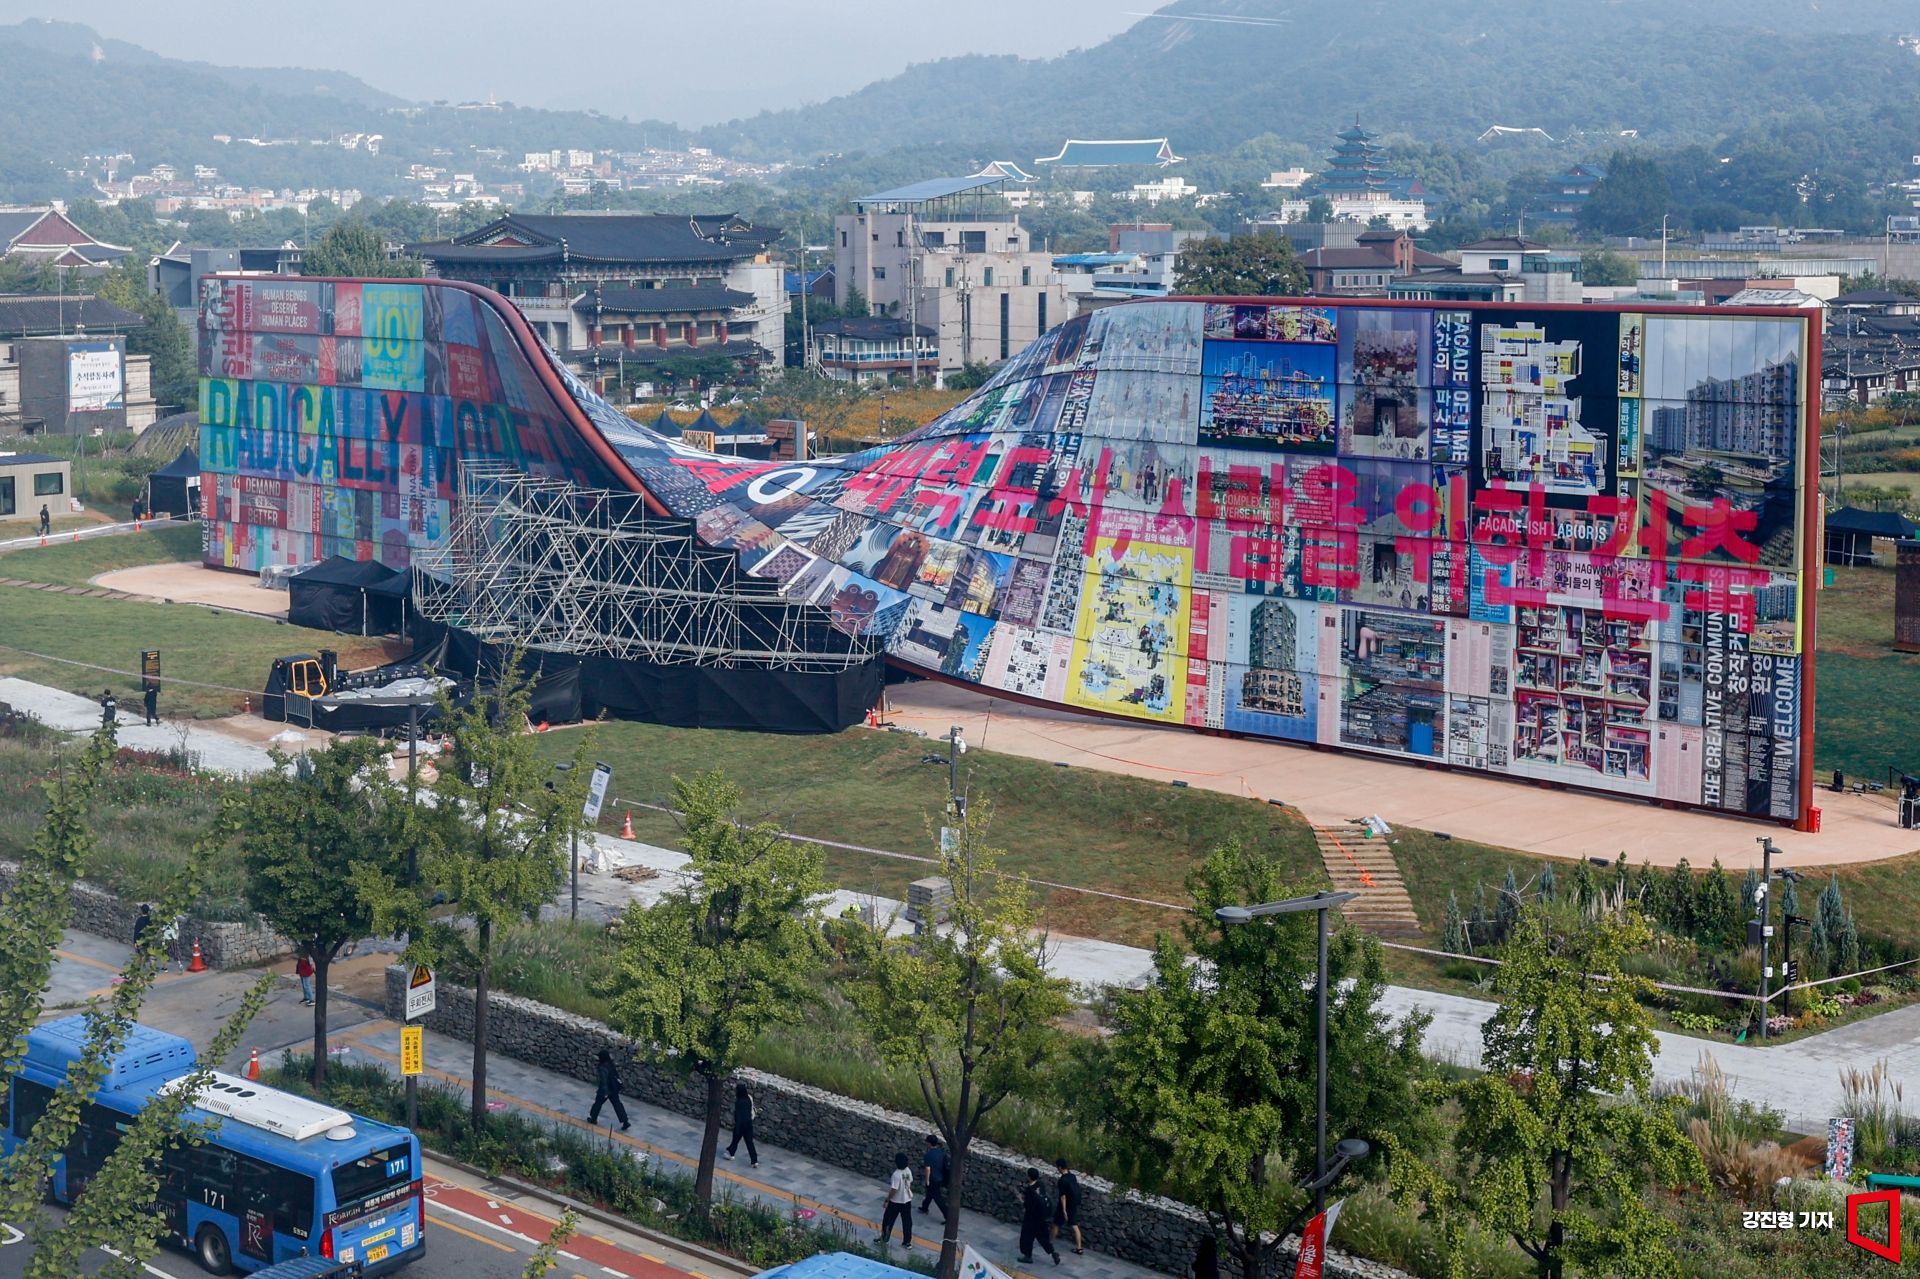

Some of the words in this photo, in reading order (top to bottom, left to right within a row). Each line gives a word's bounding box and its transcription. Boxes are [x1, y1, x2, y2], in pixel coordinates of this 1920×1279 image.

[262, 288, 285, 301] HUMAN
[285, 289, 308, 302] BEINGS
[261, 314, 285, 327] HUMAN
[285, 316, 308, 328] PLACES
[271, 302, 298, 315] DESERVE
[366, 306, 418, 359] JOY
[1435, 313, 1451, 371] 시간의
[1452, 312, 1470, 382] FACADE
[1060, 401, 1074, 427] THE
[1452, 390, 1469, 413] OF
[209, 379, 407, 487] RADICALLY
[1451, 416, 1470, 462] TIME
[245, 477, 281, 497] DEMAND
[400, 495, 409, 516] THE
[409, 446, 417, 502] ANATOMY
[1213, 492, 1220, 504] A
[1222, 494, 1262, 508] COMPLEX
[1264, 497, 1280, 509] FOR
[1215, 505, 1251, 519] DIVERSE
[1252, 508, 1280, 522] MINDS
[201, 494, 209, 553] WELCOME
[247, 507, 279, 527] BETTER
[1478, 515, 1548, 536] FACADE-ISH
[1551, 520, 1608, 542] LAB(OR)S
[844, 442, 1131, 561] 매력도시,
[1154, 456, 1366, 590] 사람을
[1395, 476, 1554, 608] 위한
[1586, 489, 1771, 633] 건축
[1251, 542, 1259, 589] WORLD
[1270, 525, 1278, 582] COMMON
[1432, 551, 1448, 560] LOVE
[1432, 569, 1449, 577] WEAR
[1555, 560, 1573, 572] OUR
[1574, 561, 1614, 577] HAGWON
[1304, 586, 1312, 597] 것
[1553, 577, 1592, 591] 우리들의
[1706, 566, 1725, 686] COMMUNITIES
[1750, 653, 1773, 696] 환영
[1774, 656, 1795, 757] WELCOME
[1705, 689, 1722, 770] CREATIVE
[1705, 771, 1721, 805] THE
[390, 1159, 405, 1174] 171
[203, 1188, 226, 1211] 171
